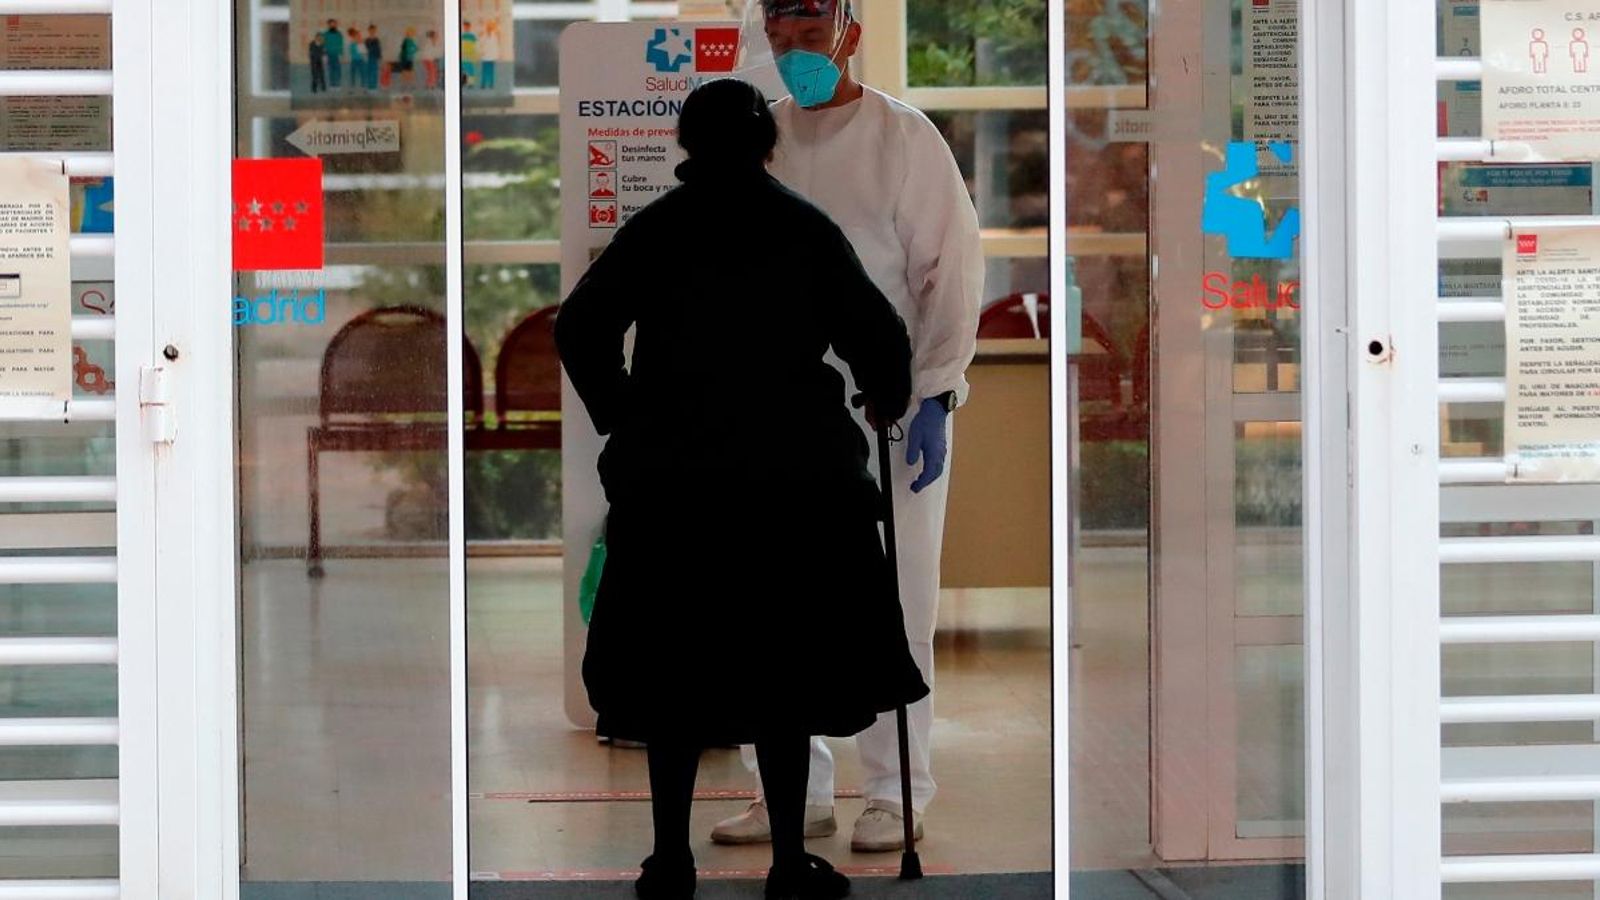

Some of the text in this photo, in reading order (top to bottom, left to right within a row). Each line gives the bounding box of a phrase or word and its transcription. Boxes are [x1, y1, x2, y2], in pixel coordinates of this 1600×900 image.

[579, 96, 682, 118] ESTACIÓN
[588, 128, 629, 137] Medidas
[632, 128, 644, 137] de
[621, 145, 666, 153] Desinfecta
[634, 184, 653, 192] boca
